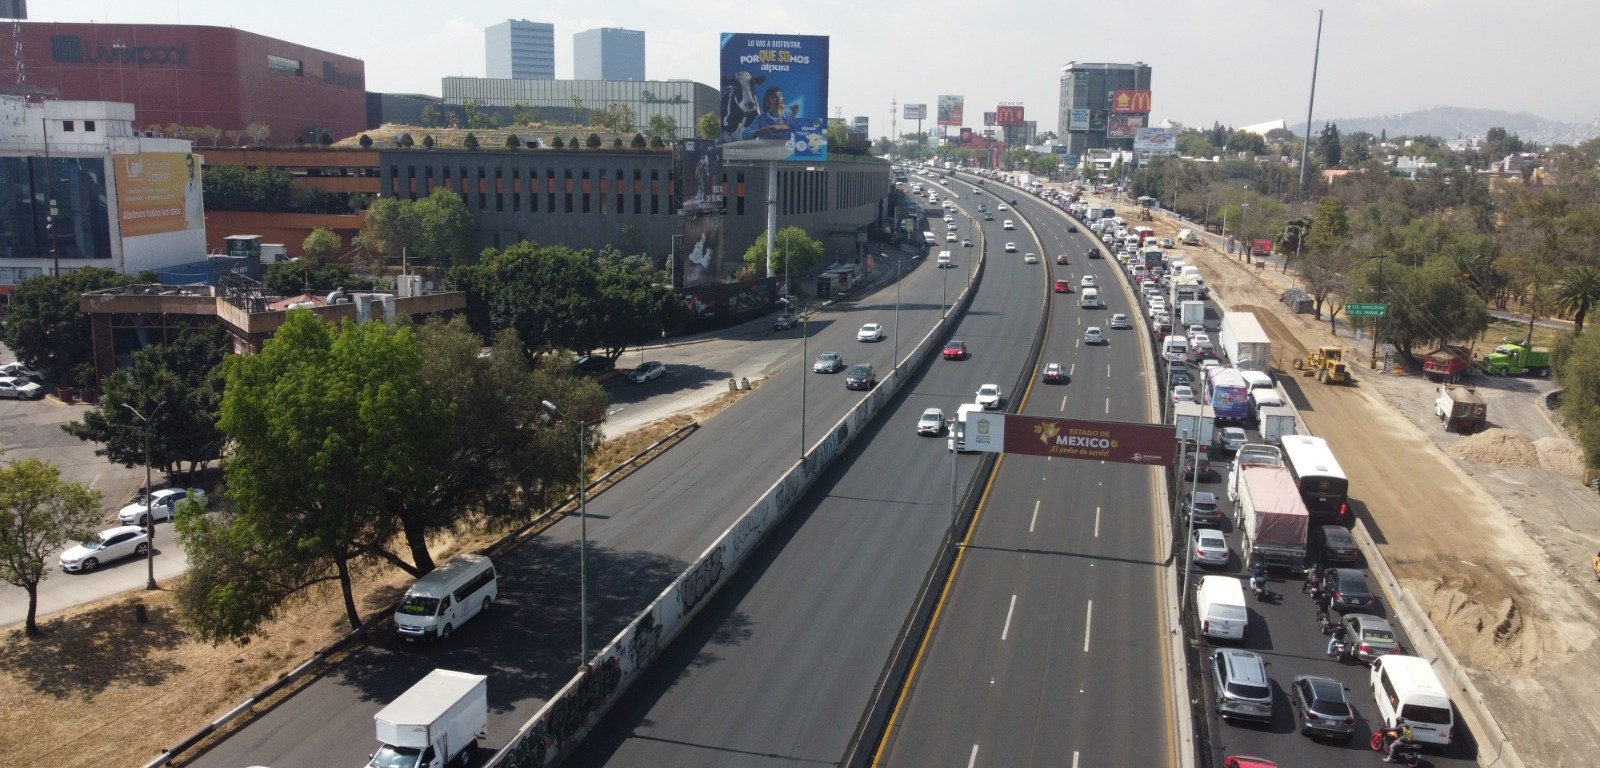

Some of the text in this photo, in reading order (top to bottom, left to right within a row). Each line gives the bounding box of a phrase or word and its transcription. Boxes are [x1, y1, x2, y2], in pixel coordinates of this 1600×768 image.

[85, 41, 188, 68] Liverpool
[761, 63, 790, 72] alpura
[123, 210, 146, 220] Abrimos
[146, 208, 161, 217] todos
[1069, 428, 1099, 436] ESTADO
[1060, 447, 1078, 455] poder
